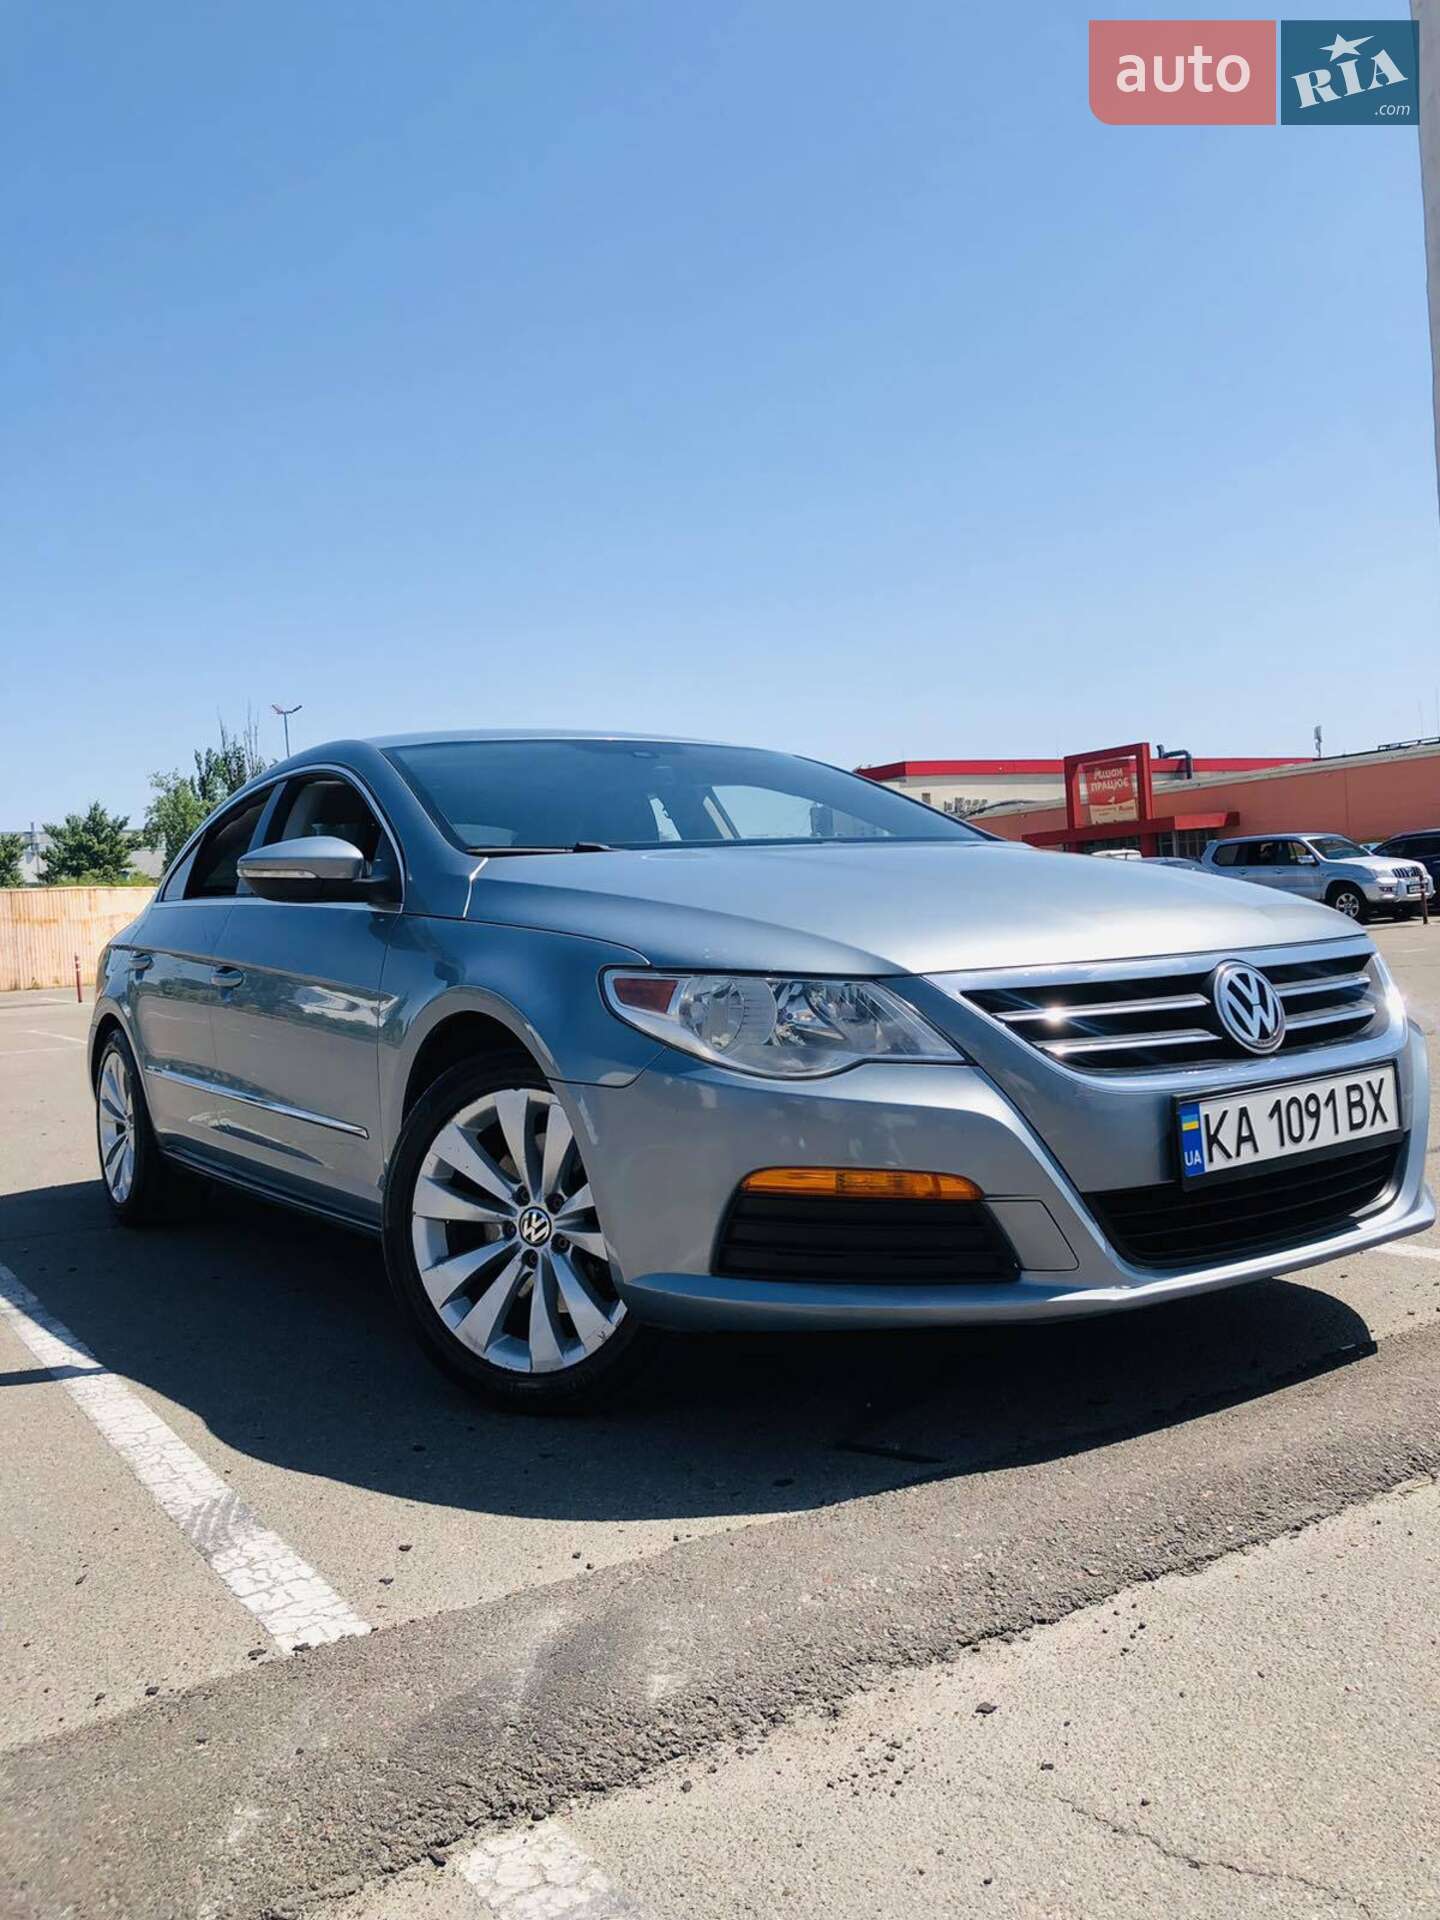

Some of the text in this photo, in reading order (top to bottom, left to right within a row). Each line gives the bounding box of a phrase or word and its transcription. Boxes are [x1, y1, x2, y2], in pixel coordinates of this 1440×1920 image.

[1204, 1078, 1388, 1163] KA 1091 BX
[1184, 1151, 1202, 1167] UA
